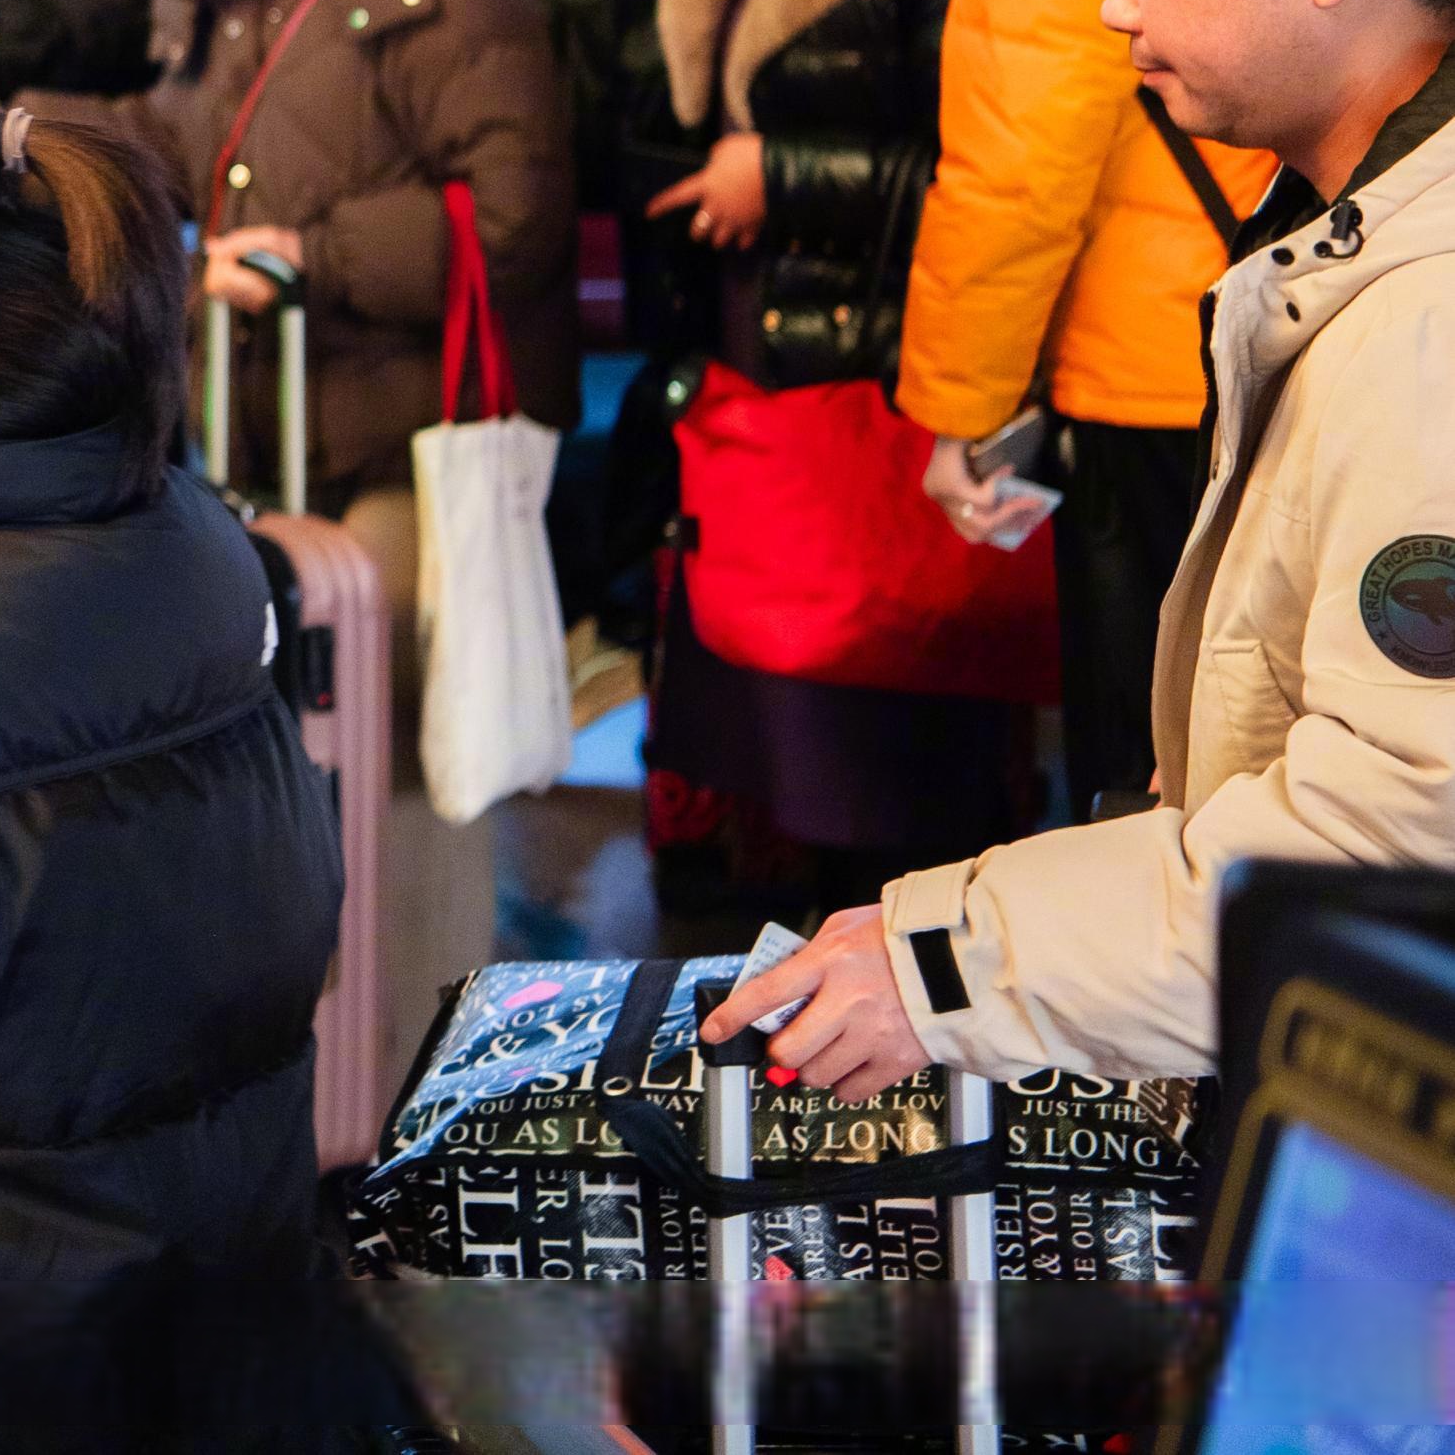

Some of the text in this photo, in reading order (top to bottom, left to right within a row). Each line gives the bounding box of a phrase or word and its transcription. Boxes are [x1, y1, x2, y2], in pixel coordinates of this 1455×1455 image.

[1366, 569, 1384, 622] GREAT
[1383, 541, 1434, 573] HOPES
[521, 1094, 578, 1113] JUST
[769, 1095, 821, 1115] ARE
[827, 1094, 883, 1112] OR
[1022, 1099, 1149, 1123] JUST THE
[513, 1118, 559, 1145] AS
[763, 1121, 938, 1152] AS LONG
[1043, 1128, 1161, 1169] LONG
[659, 1186, 684, 1254] LOVE
[1070, 1192, 1095, 1250] OUR
[1104, 1228, 1141, 1275] AS
